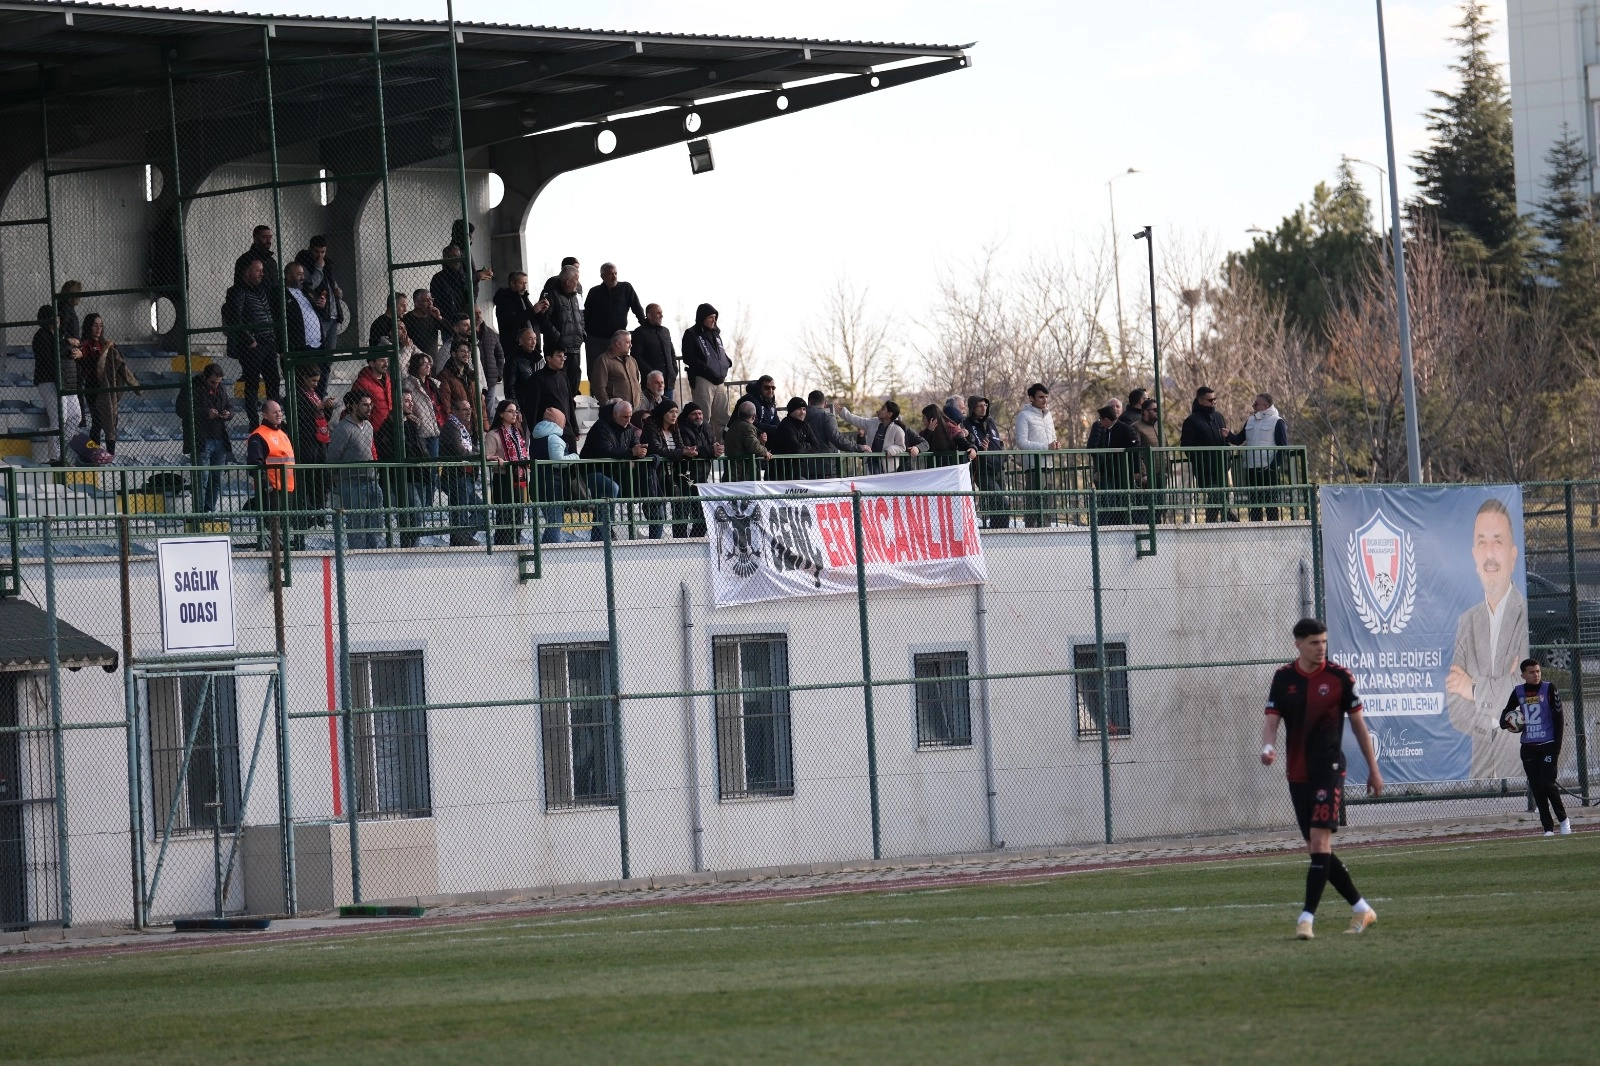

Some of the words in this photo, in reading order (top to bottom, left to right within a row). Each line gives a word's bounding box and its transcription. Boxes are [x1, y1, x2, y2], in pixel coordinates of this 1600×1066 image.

[174, 566, 219, 592] SAĞLIK
[180, 601, 218, 624] ODASI
[1332, 649, 1375, 668] SİNCAN
[1379, 648, 1442, 668] BELEDİYESİ
[1353, 672, 1433, 690] NKARASPOR'A
[1402, 695, 1439, 711] DİLERİM
[1544, 755, 1552, 763] 45
[1312, 803, 1330, 821] 26
